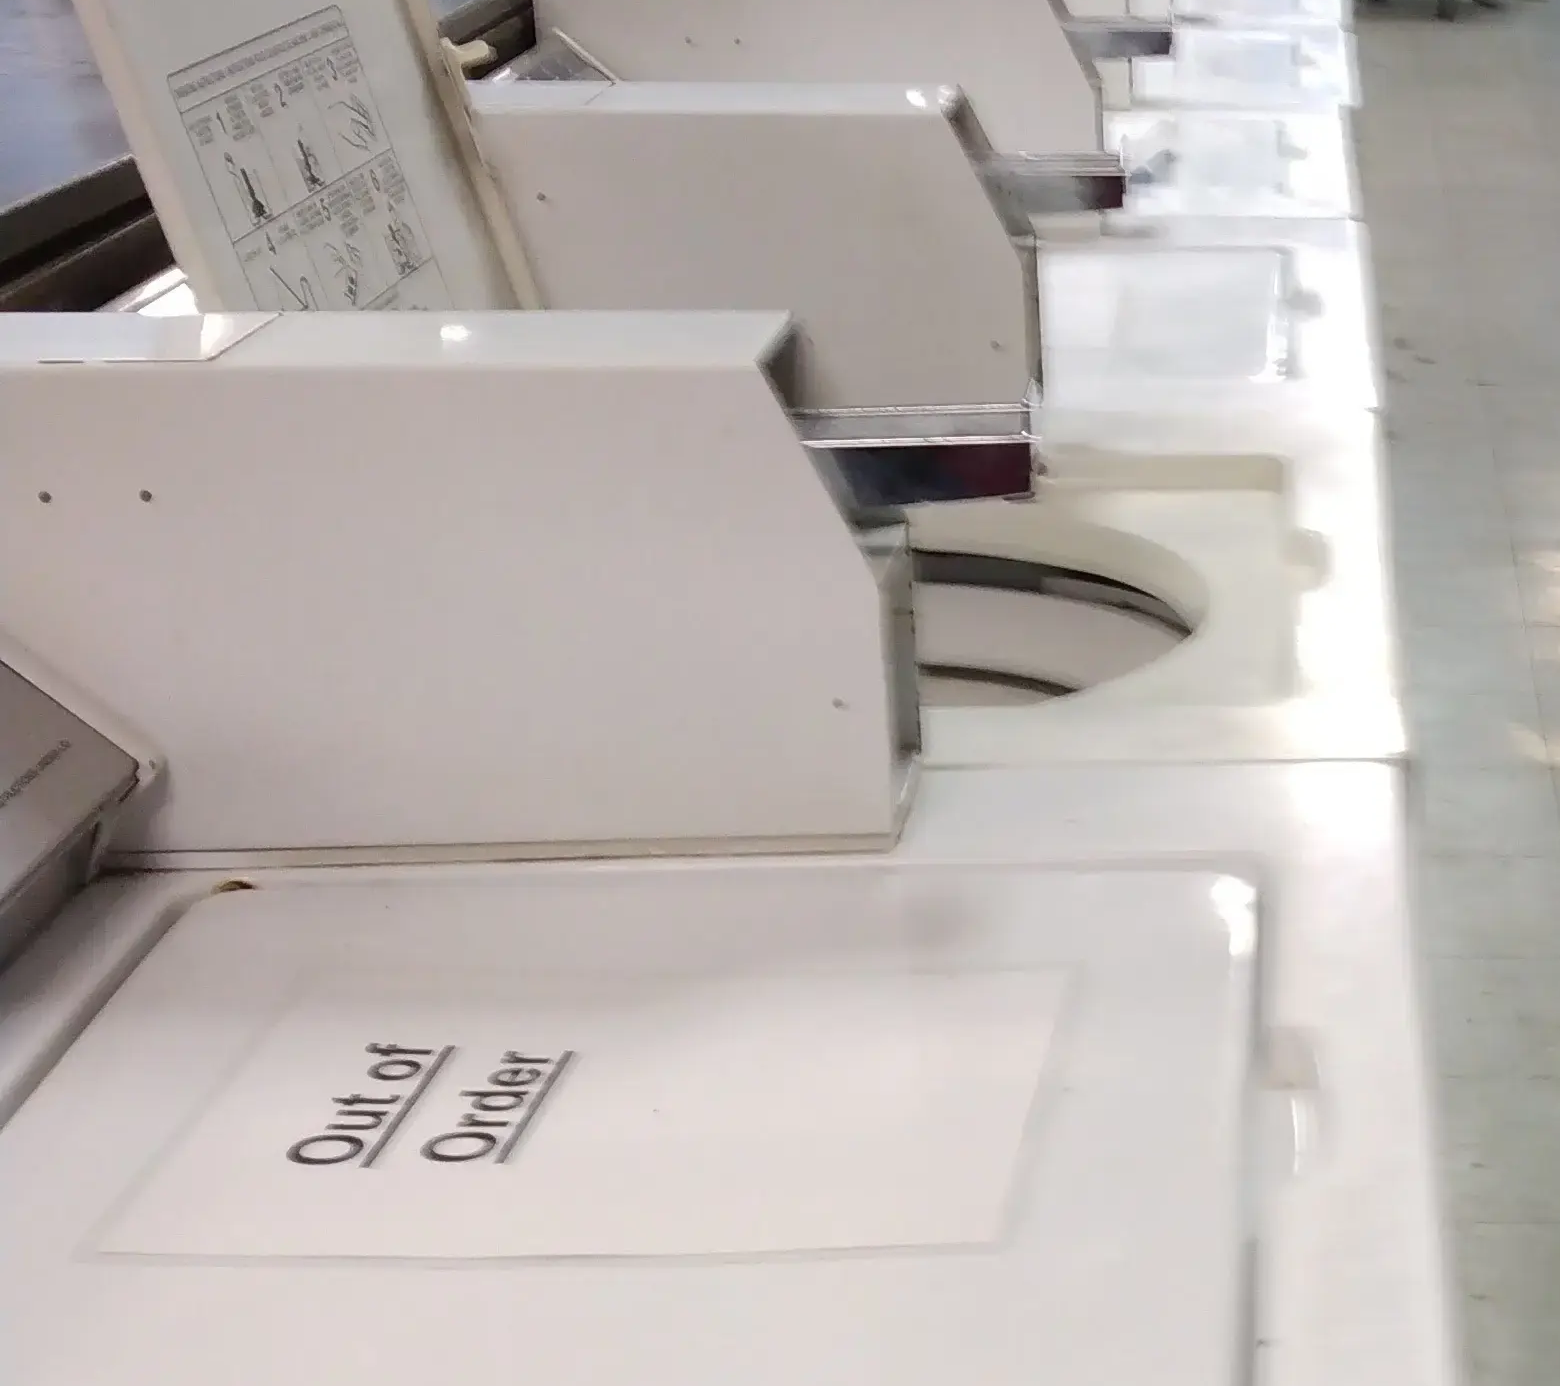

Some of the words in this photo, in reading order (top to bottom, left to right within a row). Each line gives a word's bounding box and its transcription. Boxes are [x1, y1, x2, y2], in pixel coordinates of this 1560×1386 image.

[285, 1091, 402, 1166] Out
[364, 1040, 435, 1082] of
[419, 1049, 555, 1163] Order
